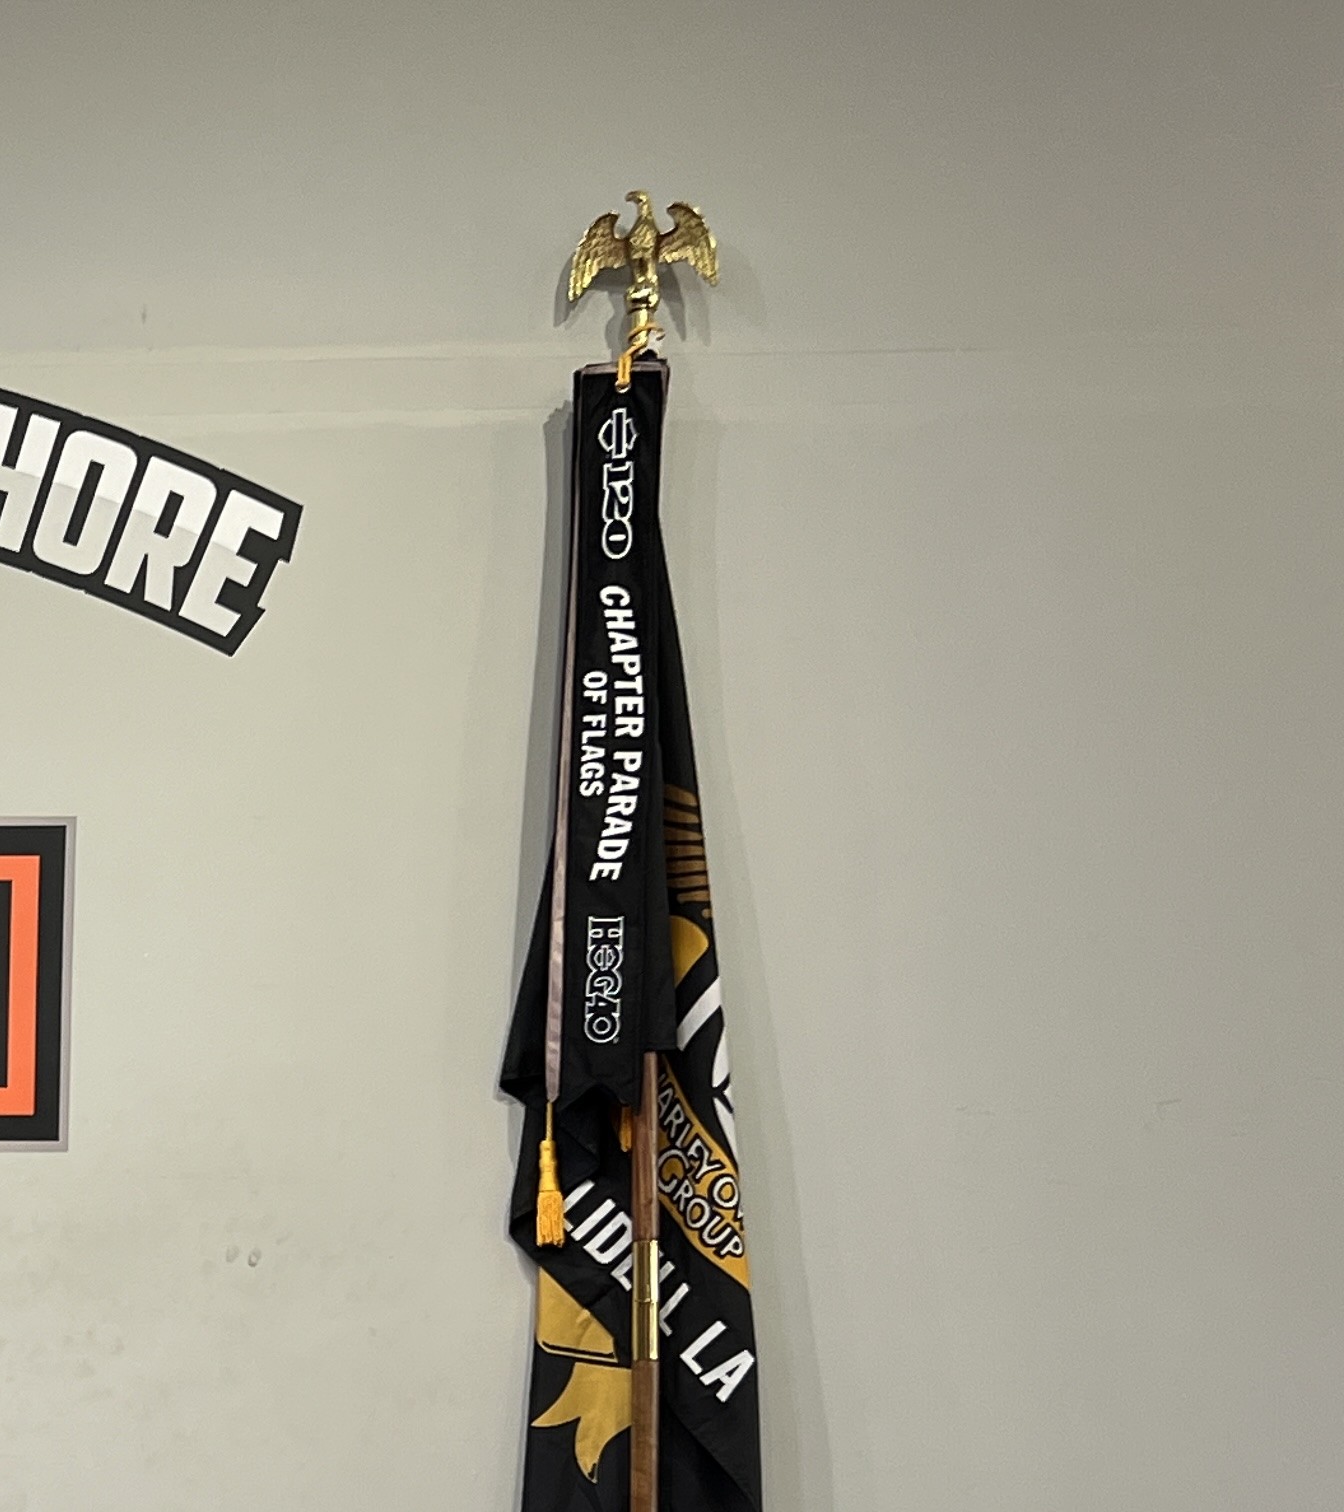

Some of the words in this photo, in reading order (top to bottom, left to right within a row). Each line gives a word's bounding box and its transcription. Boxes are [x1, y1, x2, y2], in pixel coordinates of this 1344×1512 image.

[582, 670, 608, 704] OF
[598, 585, 645, 738] CHAPTER
[579, 714, 607, 797] FLAGS
[589, 751, 643, 881] PARADE
[658, 1149, 743, 1257] GROUP
[679, 1320, 754, 1402] LA
